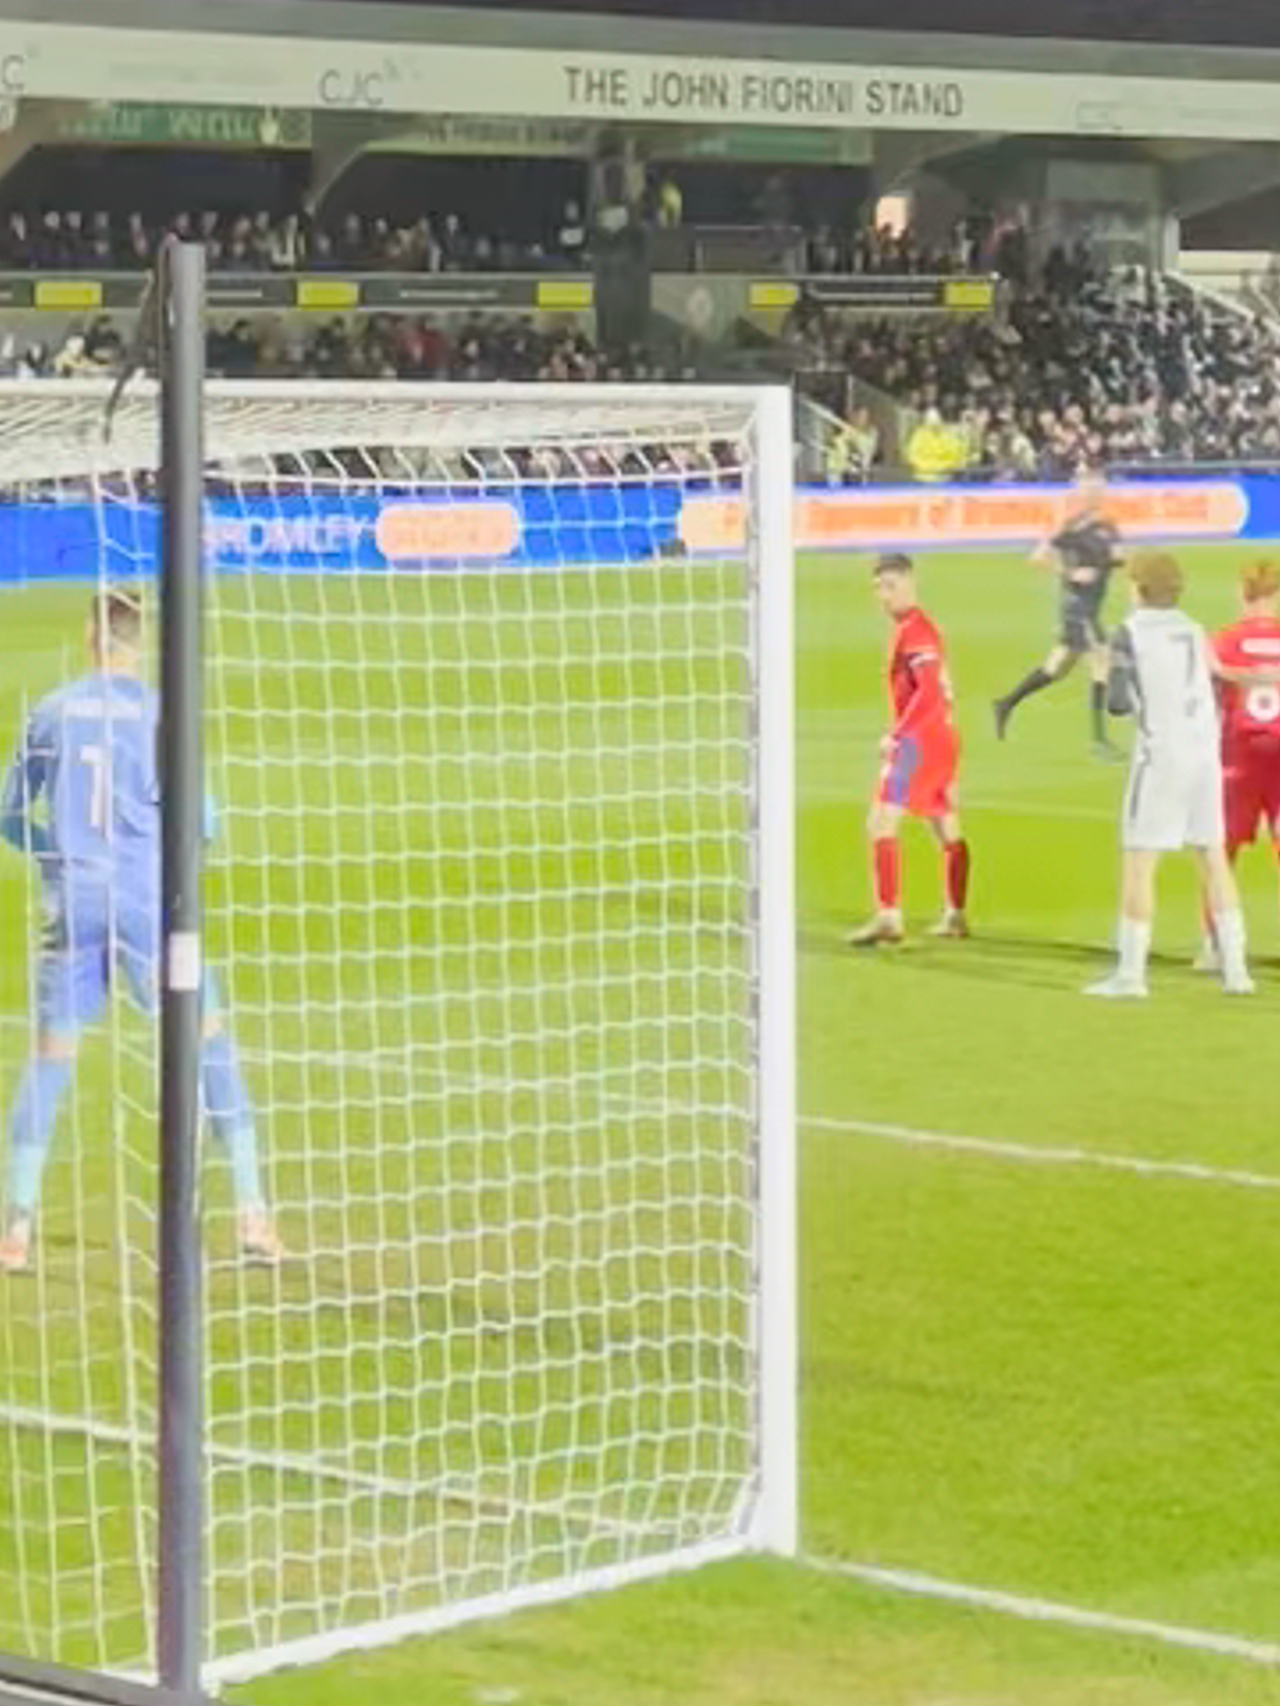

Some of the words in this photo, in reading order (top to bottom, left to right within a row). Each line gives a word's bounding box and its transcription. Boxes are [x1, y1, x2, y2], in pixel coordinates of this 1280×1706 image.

[564, 67, 627, 106] THE
[643, 72, 727, 109] JOHN
[741, 75, 854, 114] FIORINI
[866, 80, 963, 117] STAND
